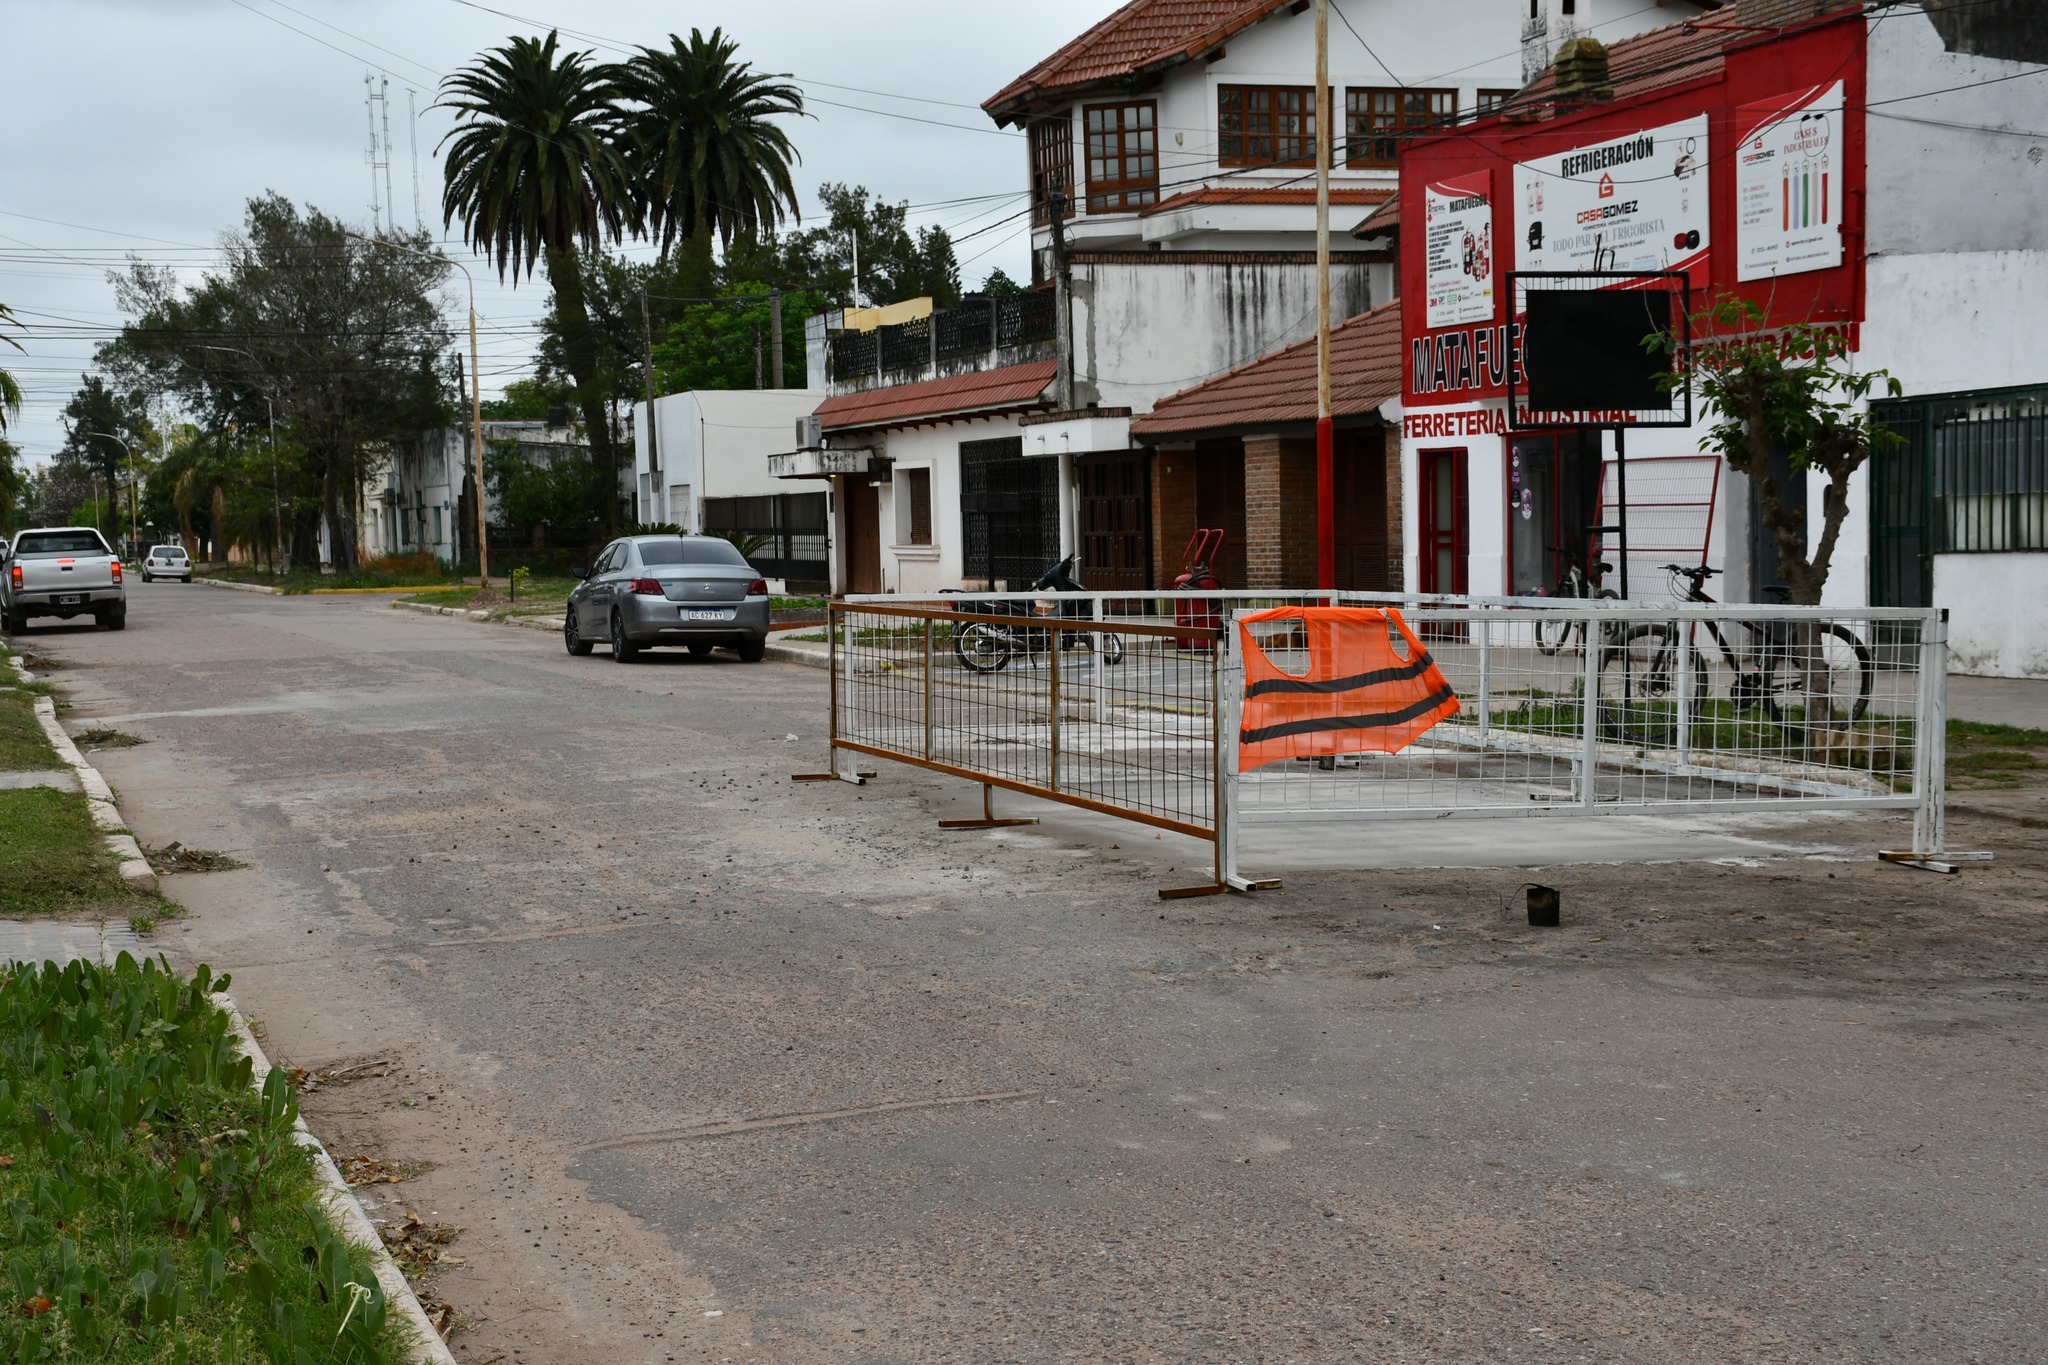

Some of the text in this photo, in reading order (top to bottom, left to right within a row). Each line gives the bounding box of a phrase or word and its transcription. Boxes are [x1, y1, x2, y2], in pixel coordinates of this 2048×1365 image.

[1783, 137, 1829, 154] INDUSTRIALES
[1794, 127, 1818, 141] GASES
[1562, 135, 1654, 178] REFRIGERACIÓN
[1449, 193, 1488, 213] MATAFUEGOS
[1577, 199, 1638, 224] CASAGOMEZ
[1553, 237, 1574, 252] TODO
[1613, 219, 1665, 241] FRIGORISTA
[1403, 408, 1508, 439] FERRETERIA
